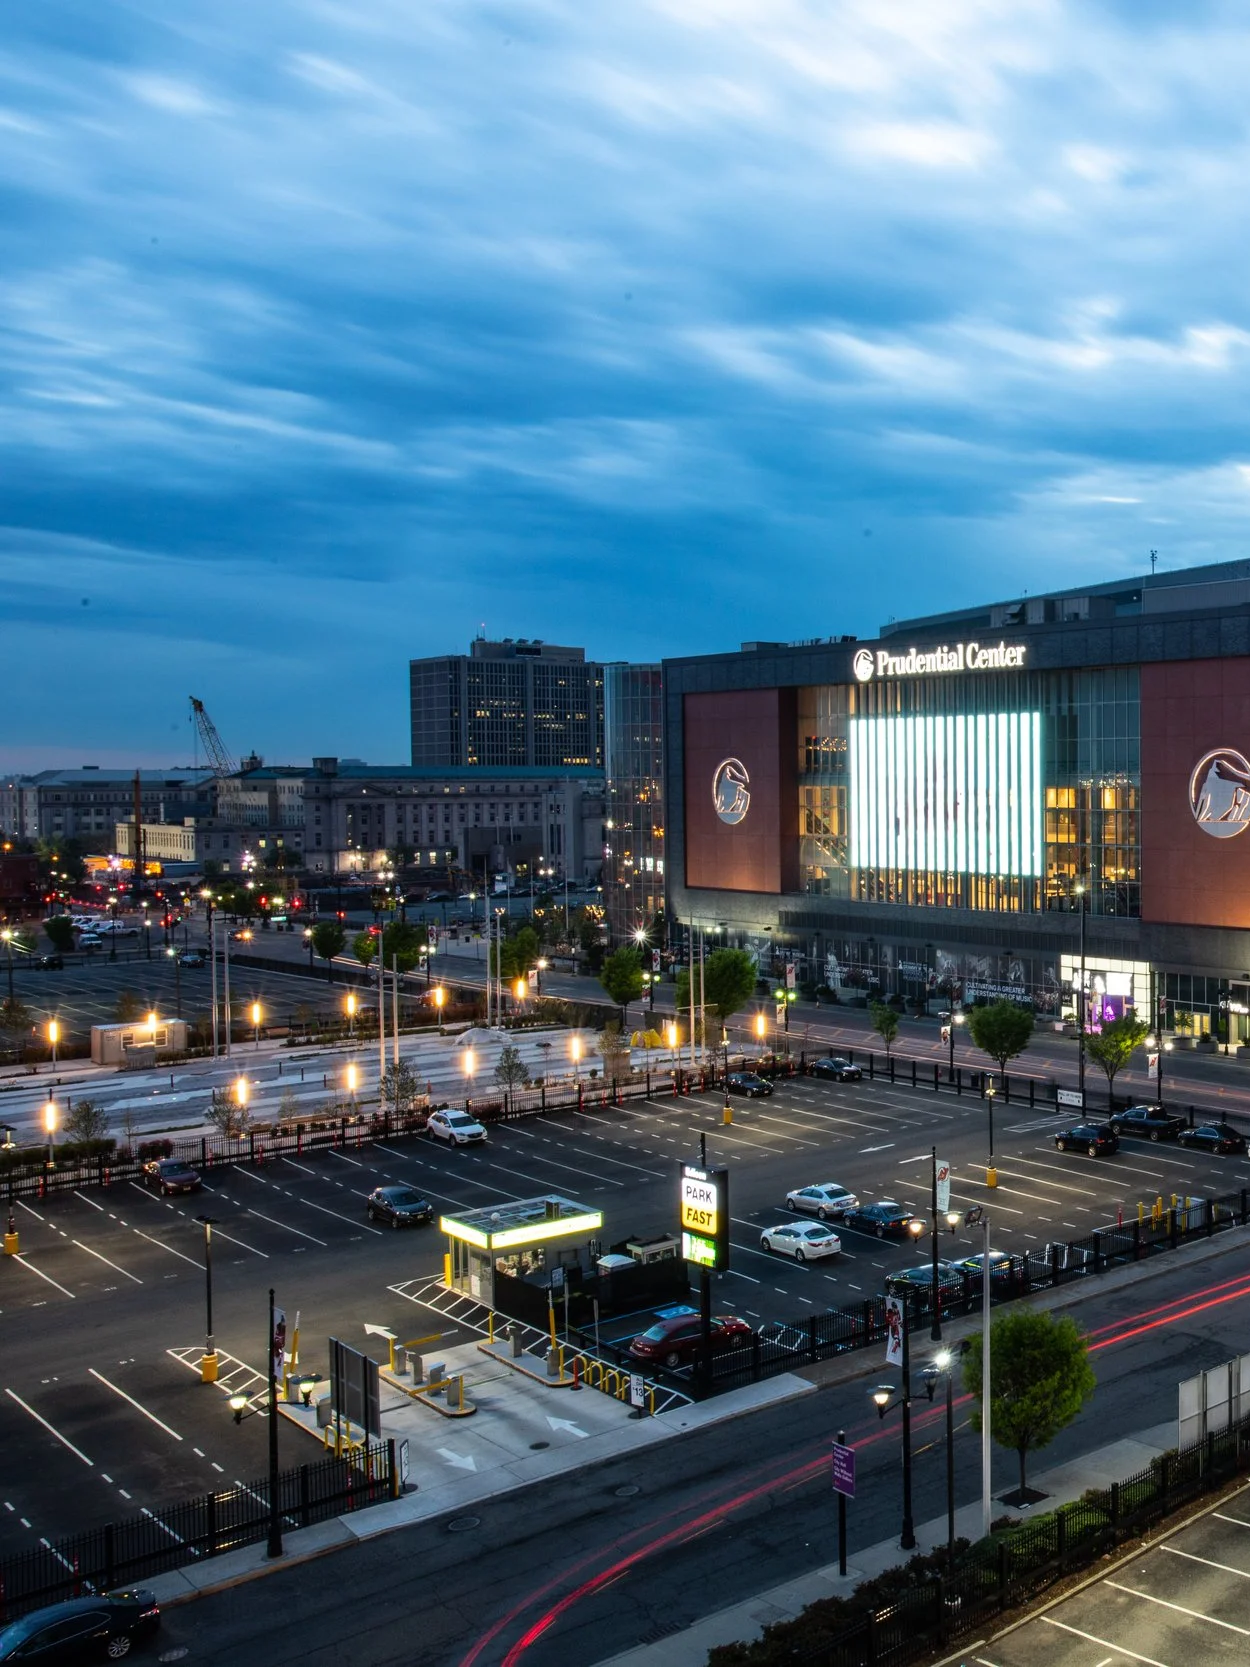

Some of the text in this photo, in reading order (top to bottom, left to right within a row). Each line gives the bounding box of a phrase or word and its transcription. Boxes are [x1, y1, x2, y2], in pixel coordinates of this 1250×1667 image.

[877, 641, 1027, 676] Prudential Center
[966, 981, 997, 992] CULTIVATING
[1002, 985, 1026, 995] GREATER
[686, 1185, 712, 1204] PARK
[686, 1207, 713, 1226] FAST
